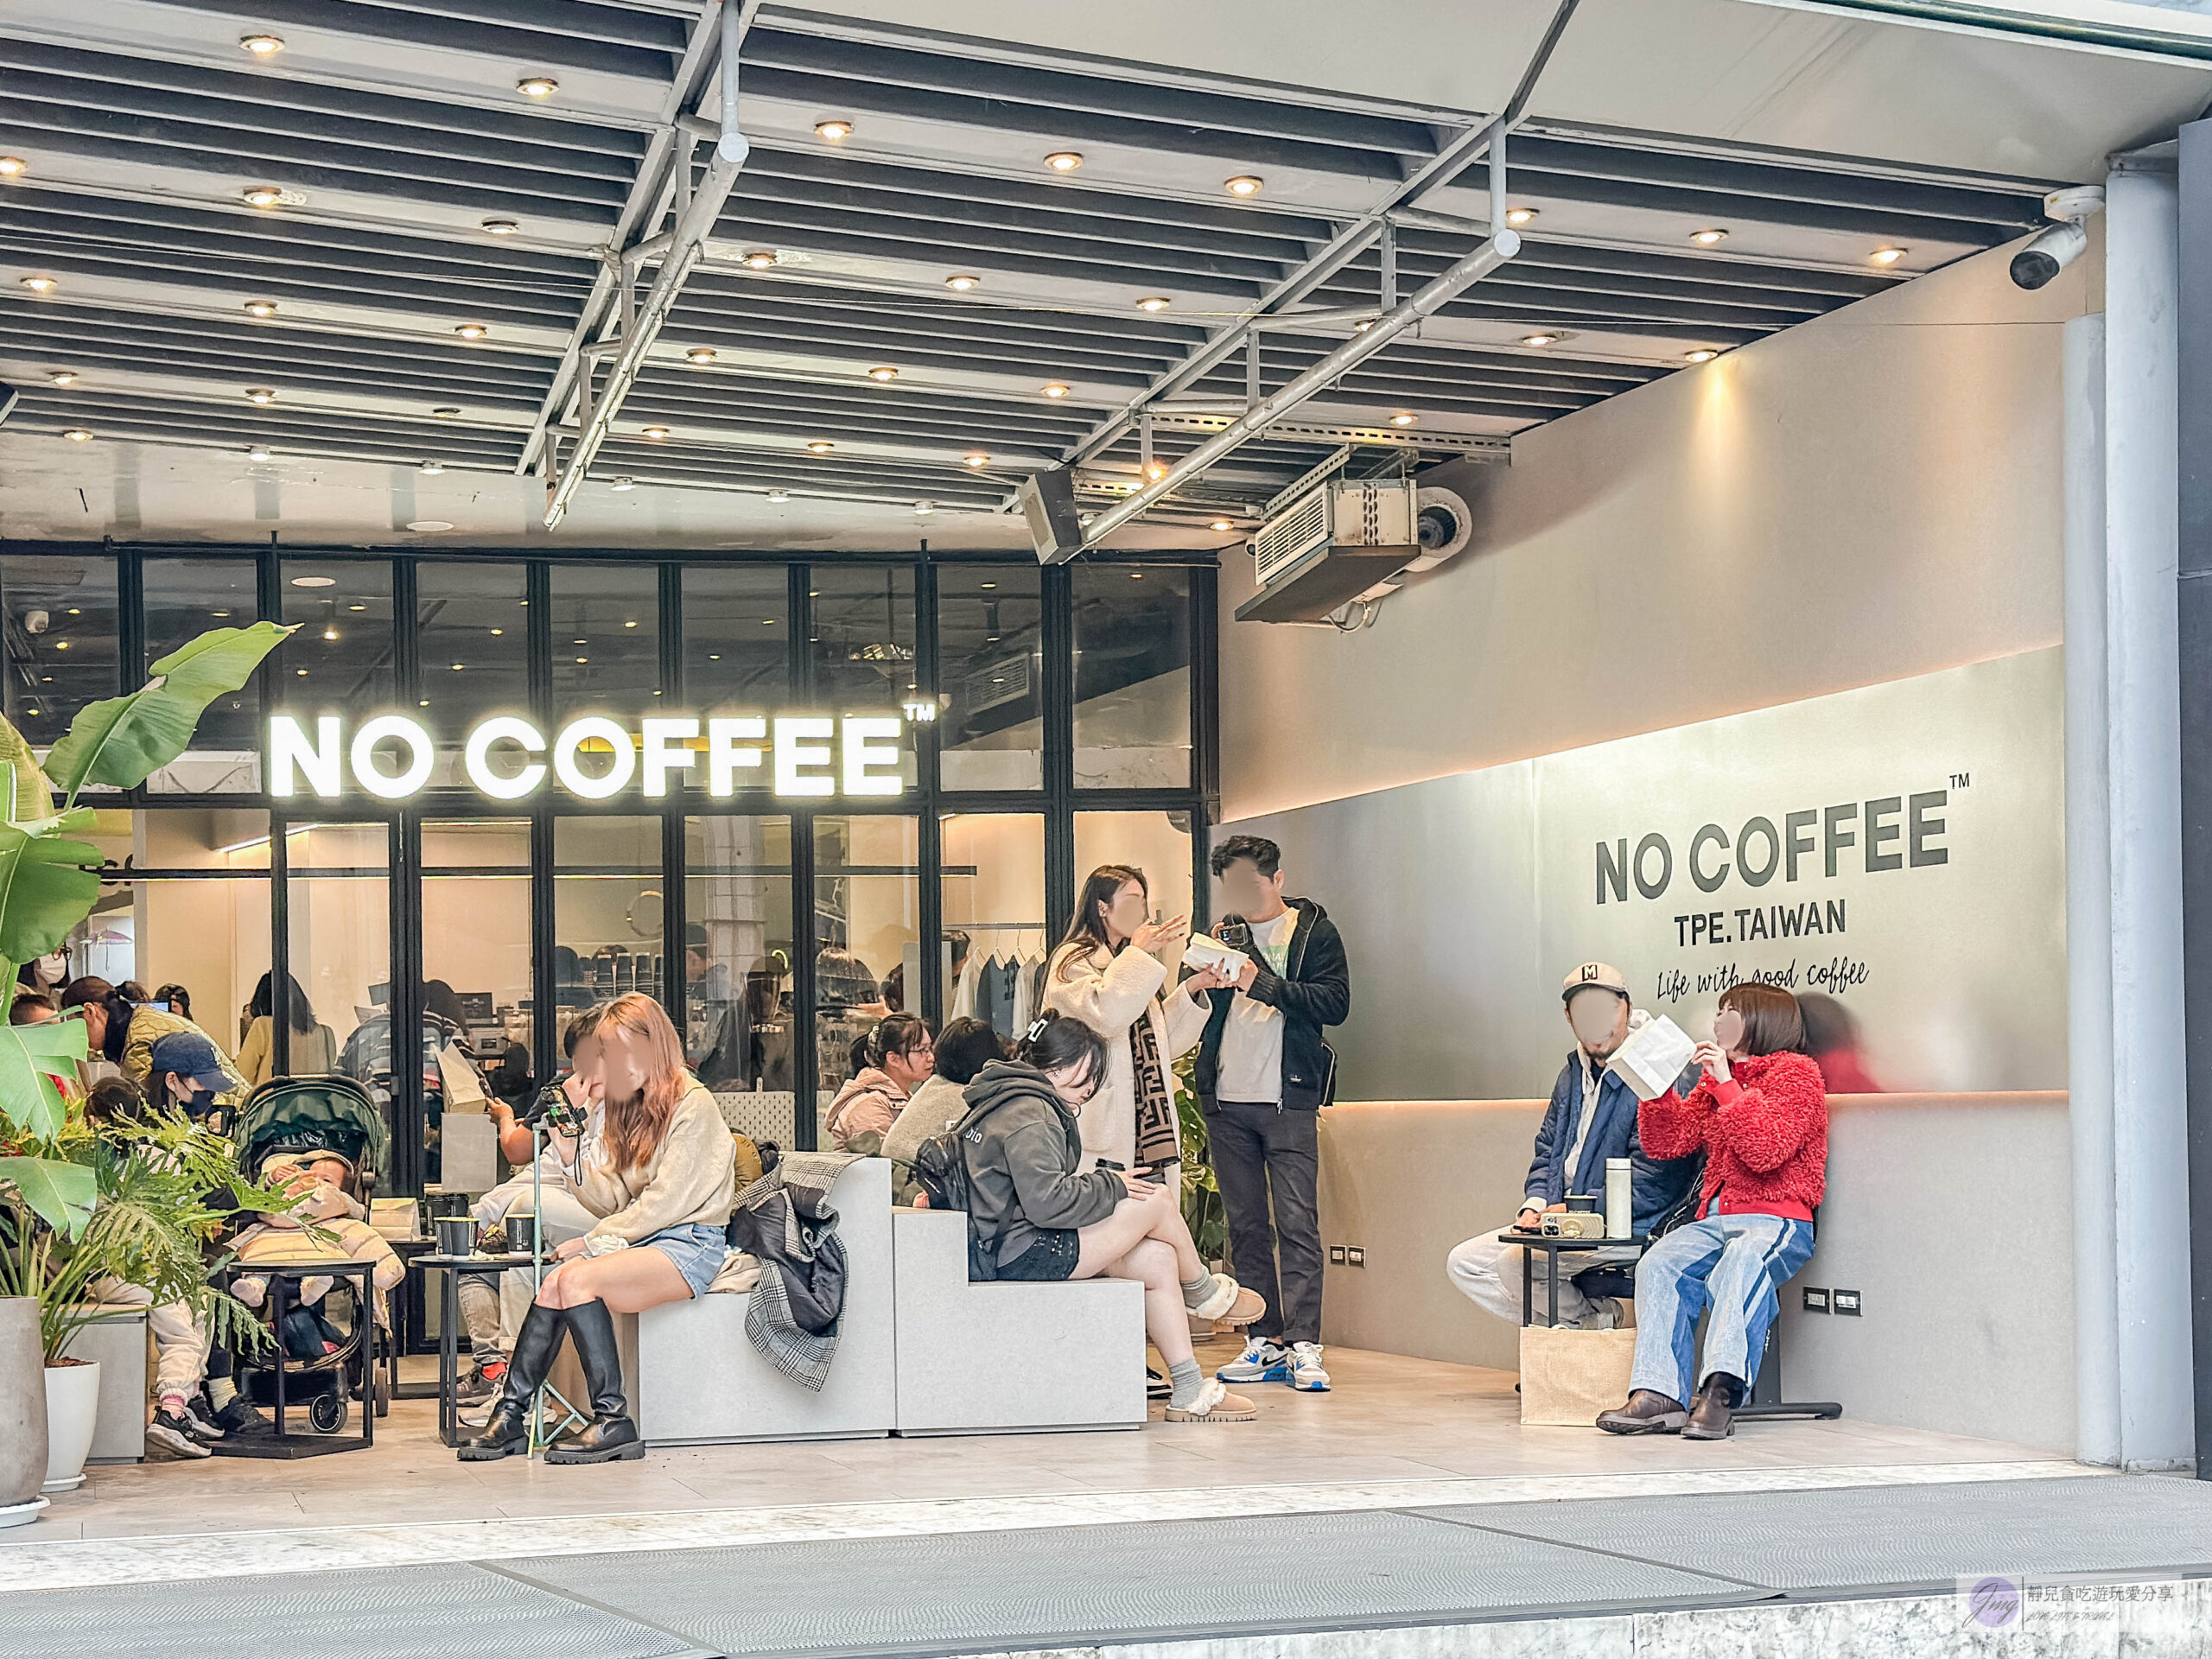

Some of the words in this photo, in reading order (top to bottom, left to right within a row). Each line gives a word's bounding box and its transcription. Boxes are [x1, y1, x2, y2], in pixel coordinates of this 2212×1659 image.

[270, 715, 434, 799] NO
[465, 715, 902, 799] COFFEE
[1596, 832, 1673, 905] NO
[1689, 790, 1948, 893] COFFEE
[1949, 772, 1970, 790] TM
[1582, 964, 1598, 982] M
[1656, 969, 1690, 1003] Life
[1697, 962, 1744, 994] with
[1807, 956, 1870, 995] coffee
